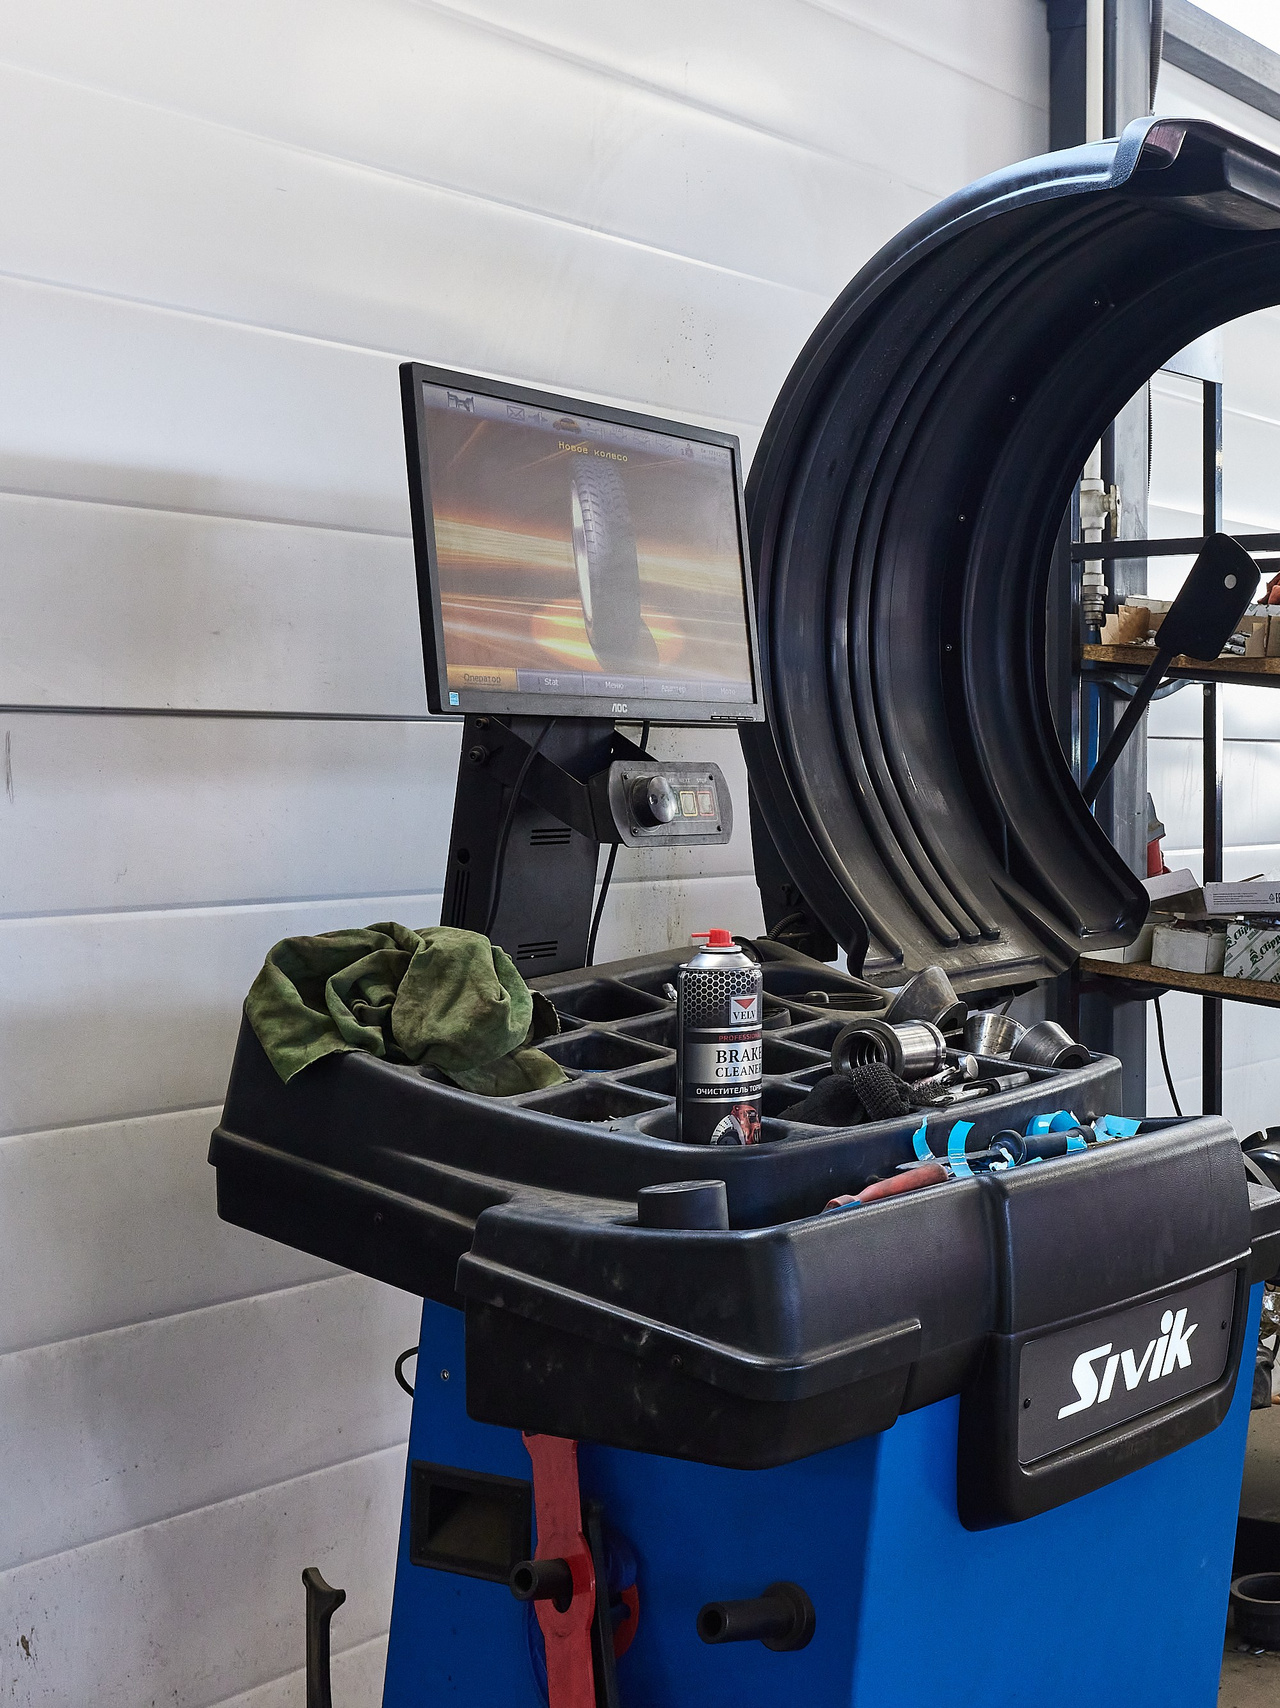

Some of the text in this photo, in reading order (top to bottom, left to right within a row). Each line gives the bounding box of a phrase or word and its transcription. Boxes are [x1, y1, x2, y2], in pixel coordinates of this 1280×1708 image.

[558, 441, 628, 462] Новое колесо
[463, 673, 502, 684] Оператор
[544, 677, 559, 687] Stat
[605, 680, 625, 690] Меню
[611, 703, 628, 713] AOC
[716, 1046, 762, 1064] BRAKE
[696, 1086, 749, 1095] ОЧИСТИТЕЛЬ
[1057, 1307, 1199, 1420] Sivik
